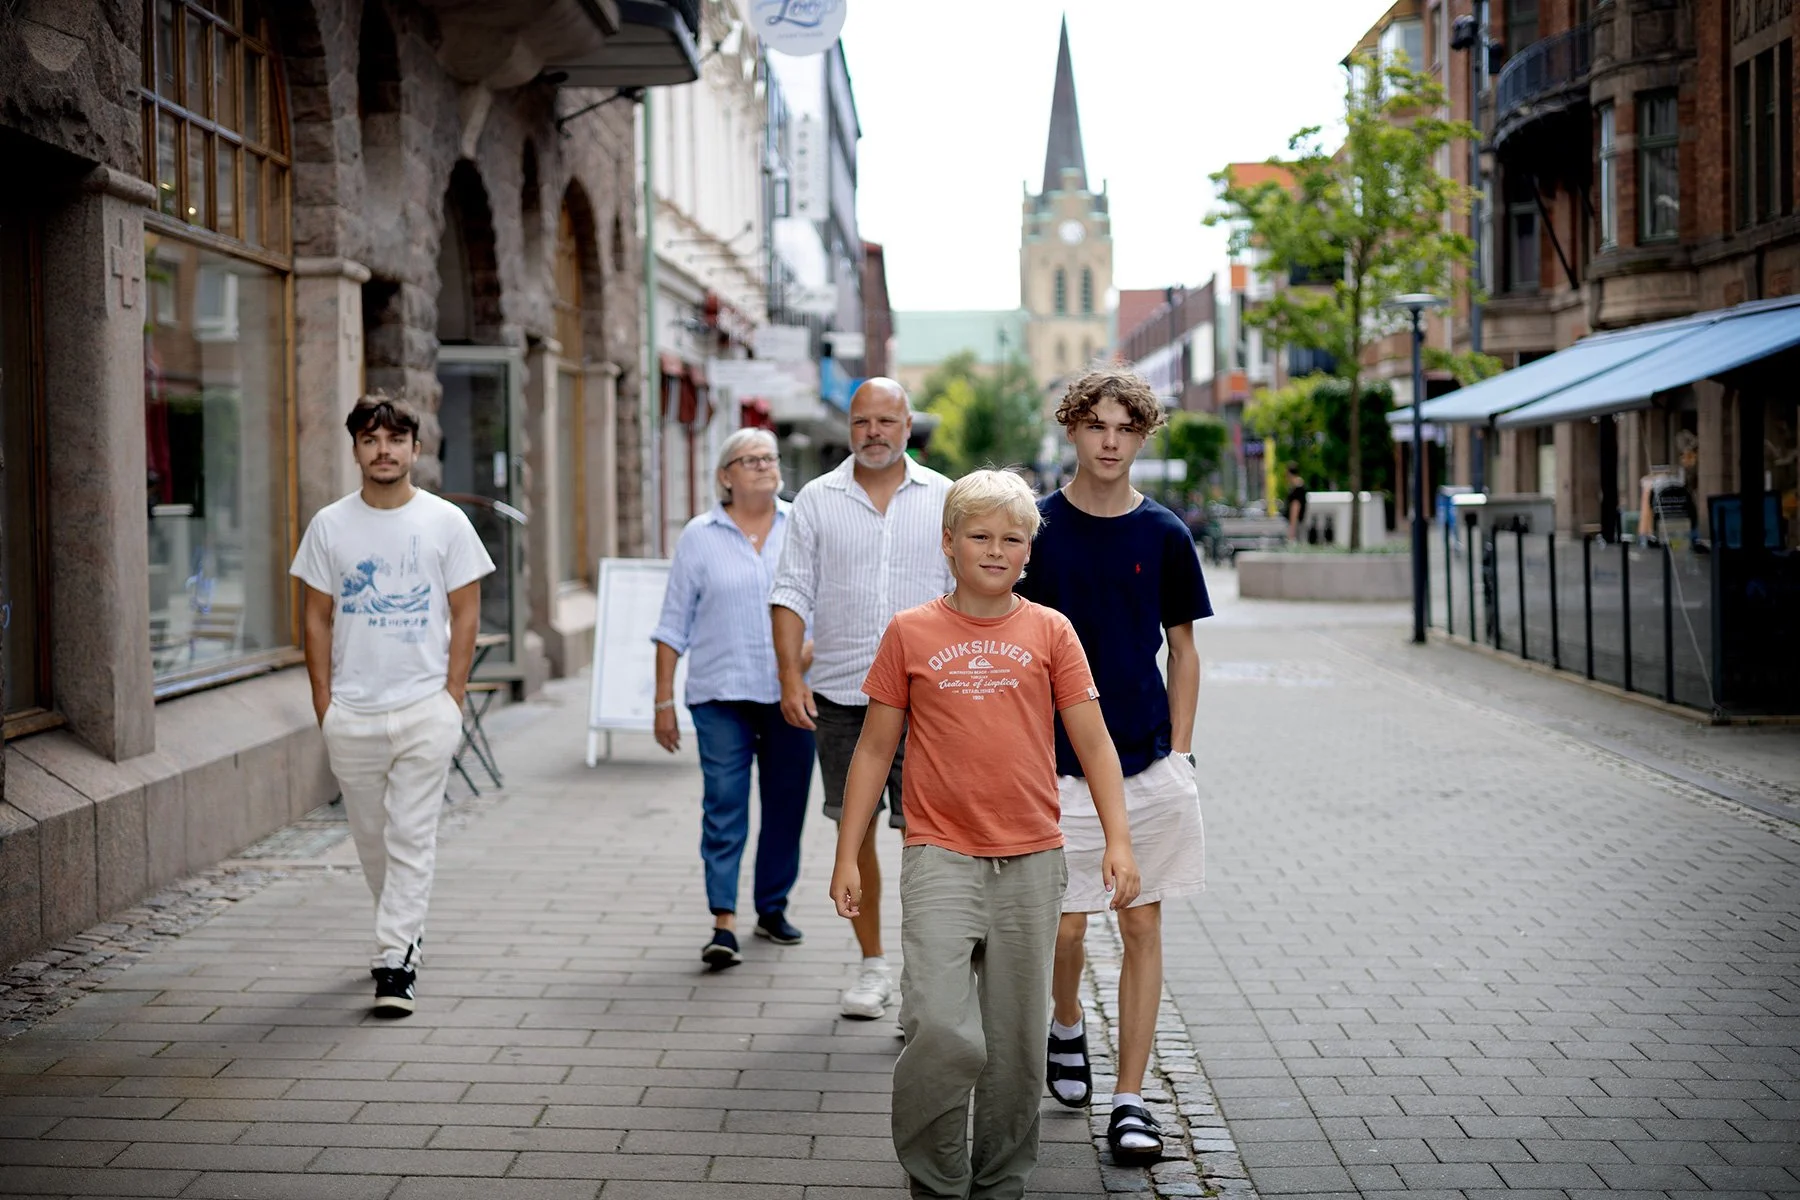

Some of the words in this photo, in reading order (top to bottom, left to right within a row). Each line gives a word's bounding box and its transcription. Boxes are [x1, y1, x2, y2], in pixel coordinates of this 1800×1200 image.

[928, 640, 1033, 671] QUIKSILVER
[939, 679, 970, 689] Creators
[973, 679, 983, 689] of
[984, 678, 1020, 688] simplicity
